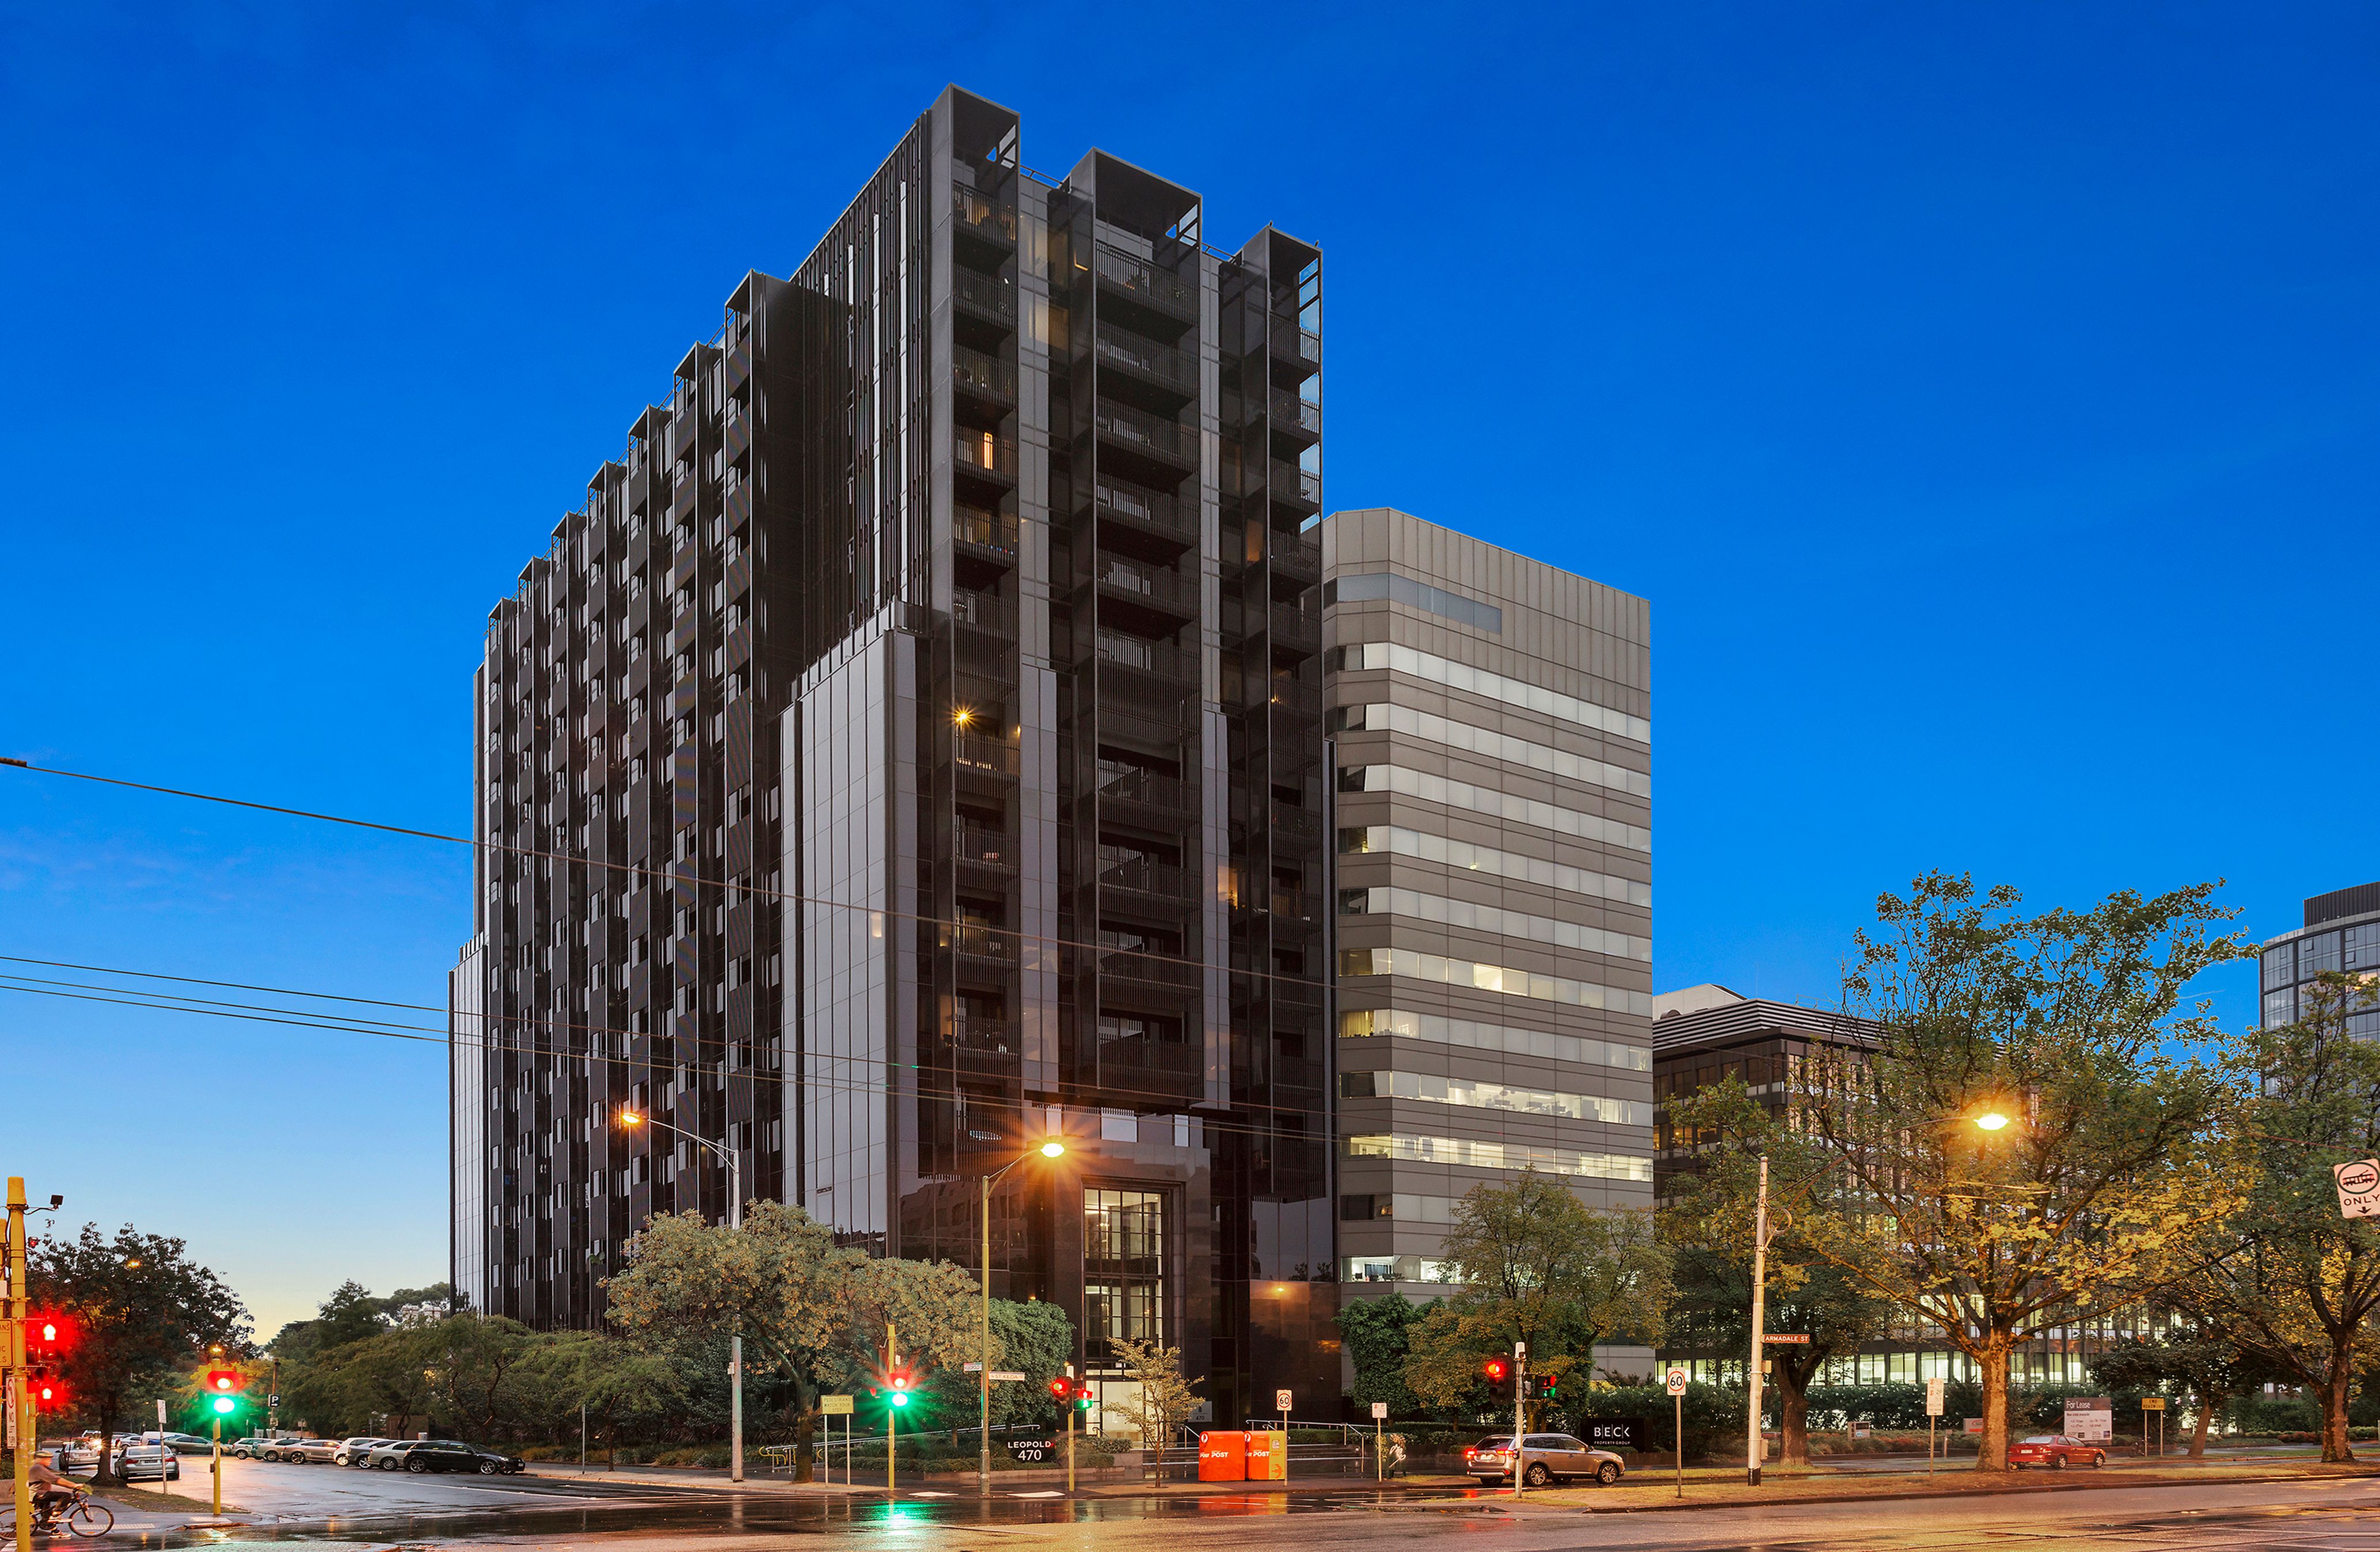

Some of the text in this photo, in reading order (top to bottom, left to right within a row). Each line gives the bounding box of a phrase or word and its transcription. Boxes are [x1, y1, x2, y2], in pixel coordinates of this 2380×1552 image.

[2344, 1194, 2380, 1206] ONLY
[1670, 1376, 1683, 1387] 60
[2066, 1401, 2090, 1409] For Lease
[1018, 1449, 1042, 1461] 470
